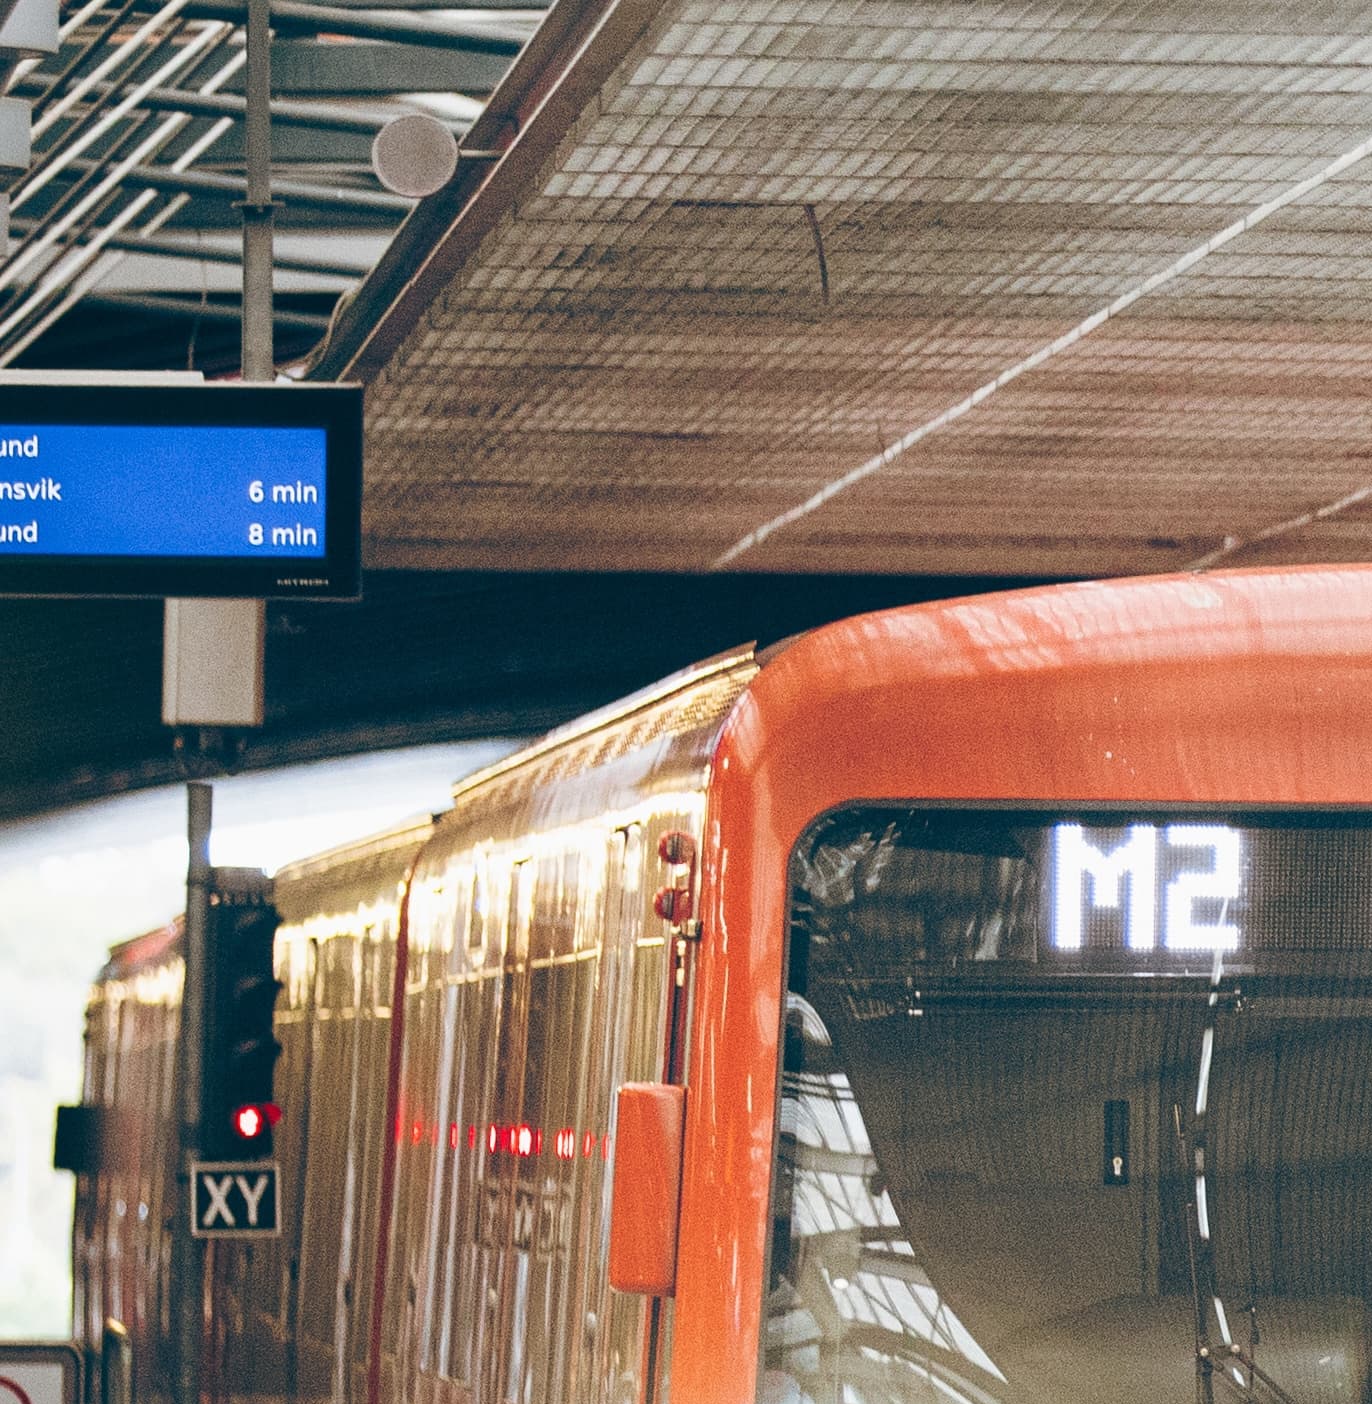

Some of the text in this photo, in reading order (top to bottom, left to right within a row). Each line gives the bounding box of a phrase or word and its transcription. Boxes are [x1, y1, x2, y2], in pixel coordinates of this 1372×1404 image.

[0, 477, 62, 501] nsvik
[249, 480, 318, 503] 6 min
[248, 522, 317, 546] 8 min
[1054, 823, 1240, 951] M2
[203, 1175, 268, 1227] XY
